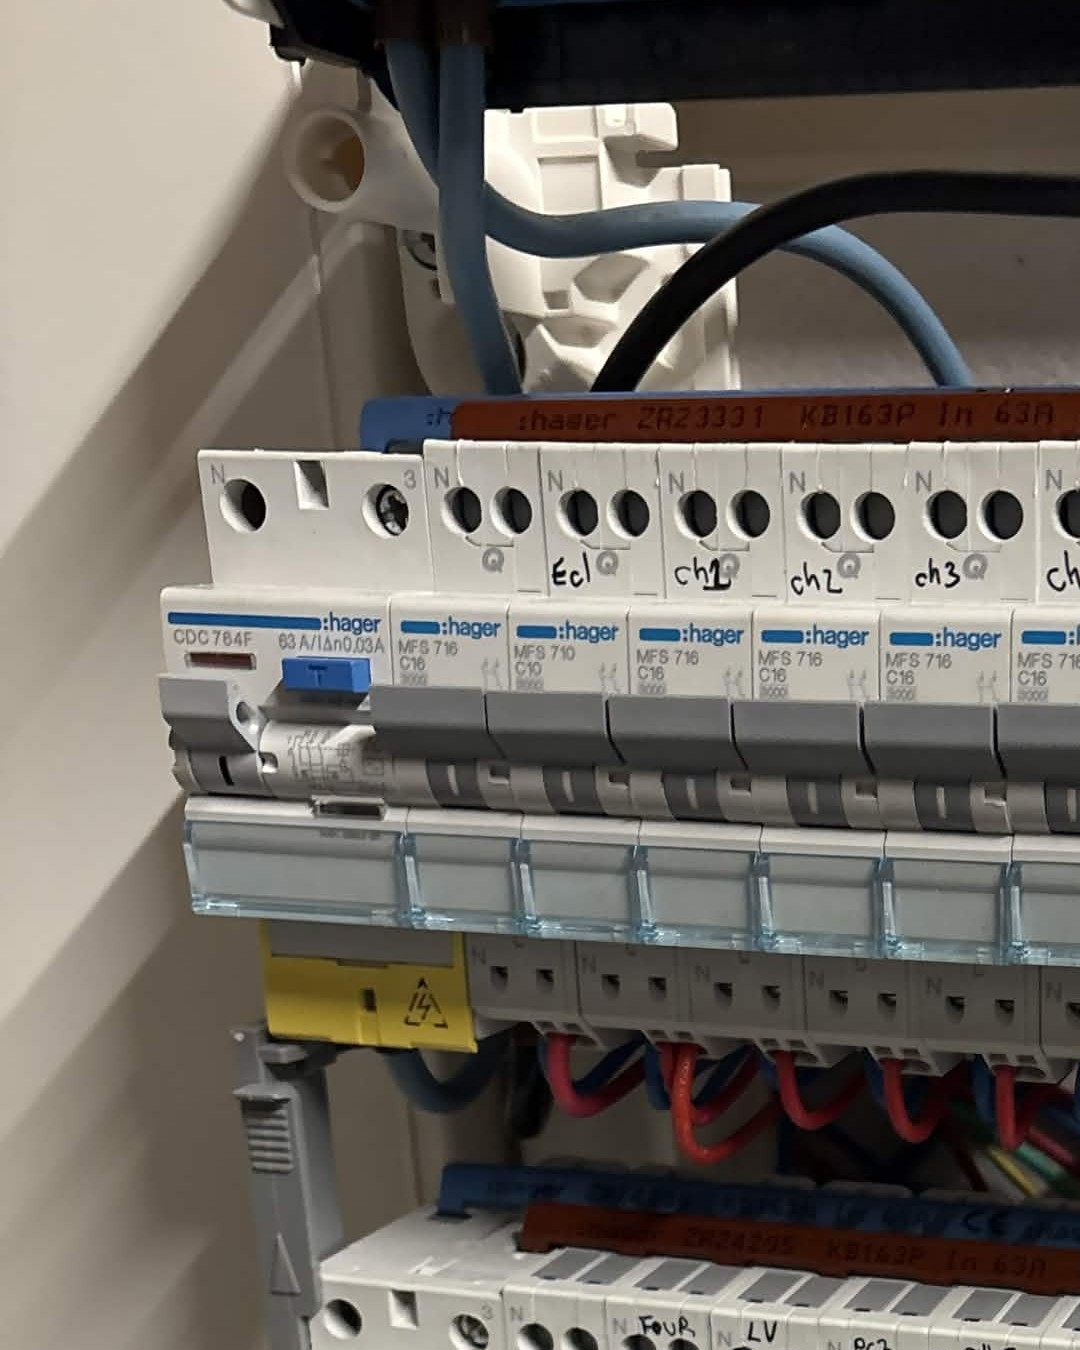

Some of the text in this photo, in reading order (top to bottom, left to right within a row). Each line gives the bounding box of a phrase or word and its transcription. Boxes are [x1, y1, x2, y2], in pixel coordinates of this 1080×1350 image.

[210, 464, 225, 485] N
[403, 469, 416, 489] 3
[434, 467, 450, 489] N
[549, 469, 565, 491] N
[669, 472, 684, 493] N
[790, 471, 806, 493] N
[916, 470, 932, 492] N
[1046, 470, 1063, 490] N
[398, 640, 458, 656] MFS 716
[514, 645, 576, 661] MFS 710
[636, 649, 700, 666] MFS 716
[758, 651, 823, 667] MFS 716
[885, 653, 953, 669] MFS 716
[1017, 653, 1053, 669] MFS
[747, 1320, 778, 1343] LV
